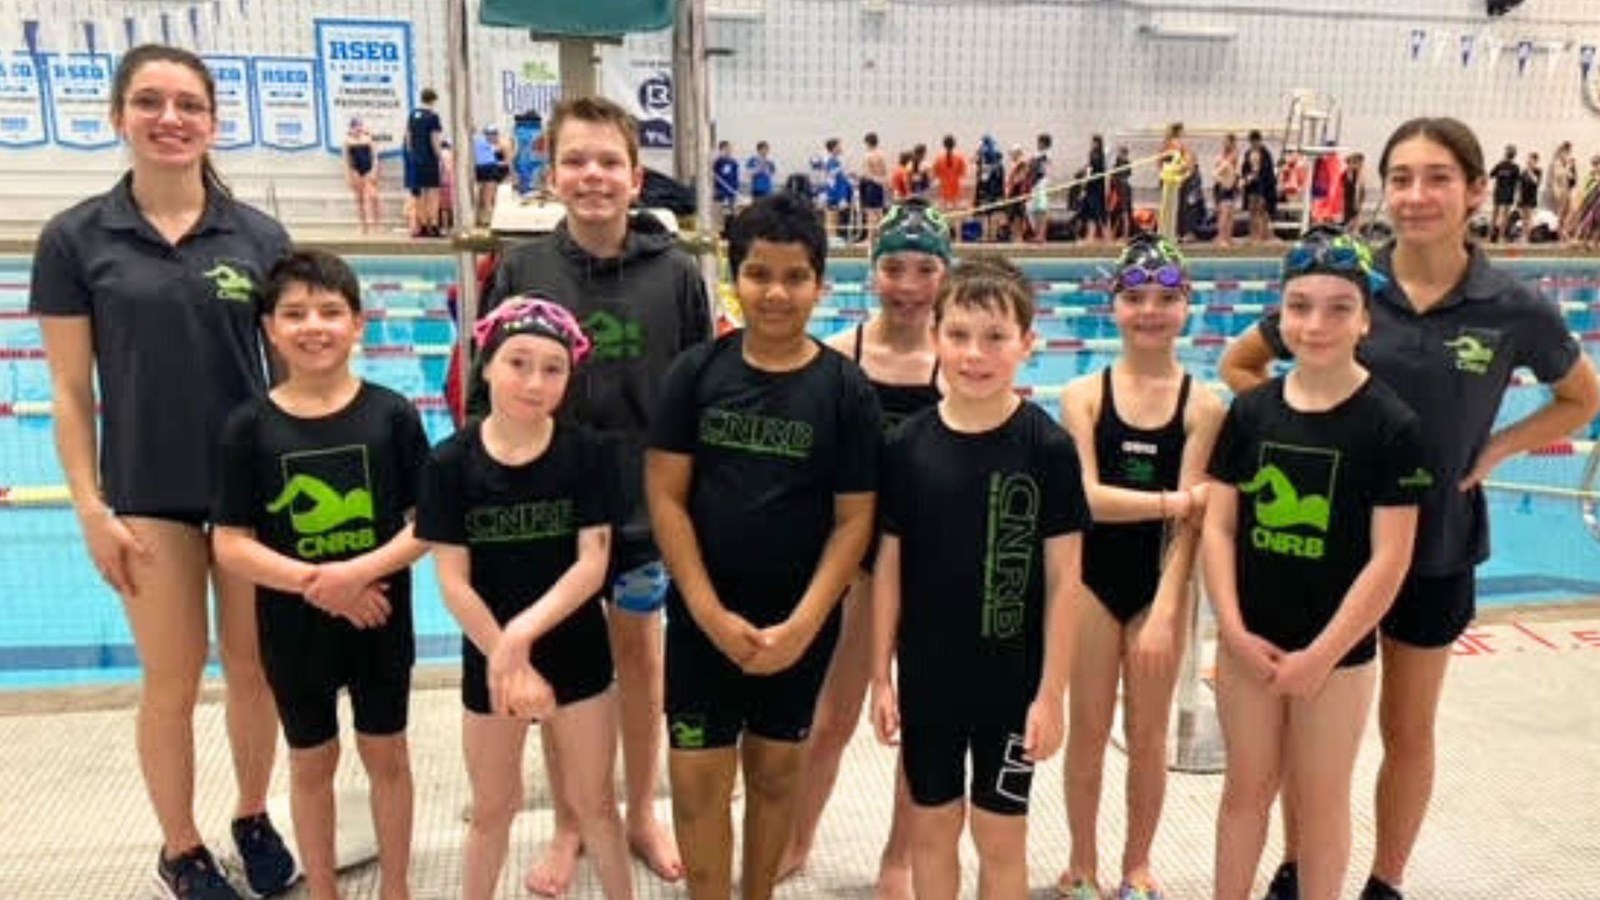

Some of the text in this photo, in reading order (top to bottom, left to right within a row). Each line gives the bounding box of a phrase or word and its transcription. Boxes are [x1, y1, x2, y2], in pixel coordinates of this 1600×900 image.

[329, 41, 399, 60] RSEQ
[297, 527, 375, 558] CNRB
[999, 473, 1040, 639] CNRB
[1250, 526, 1325, 559] CNRB
